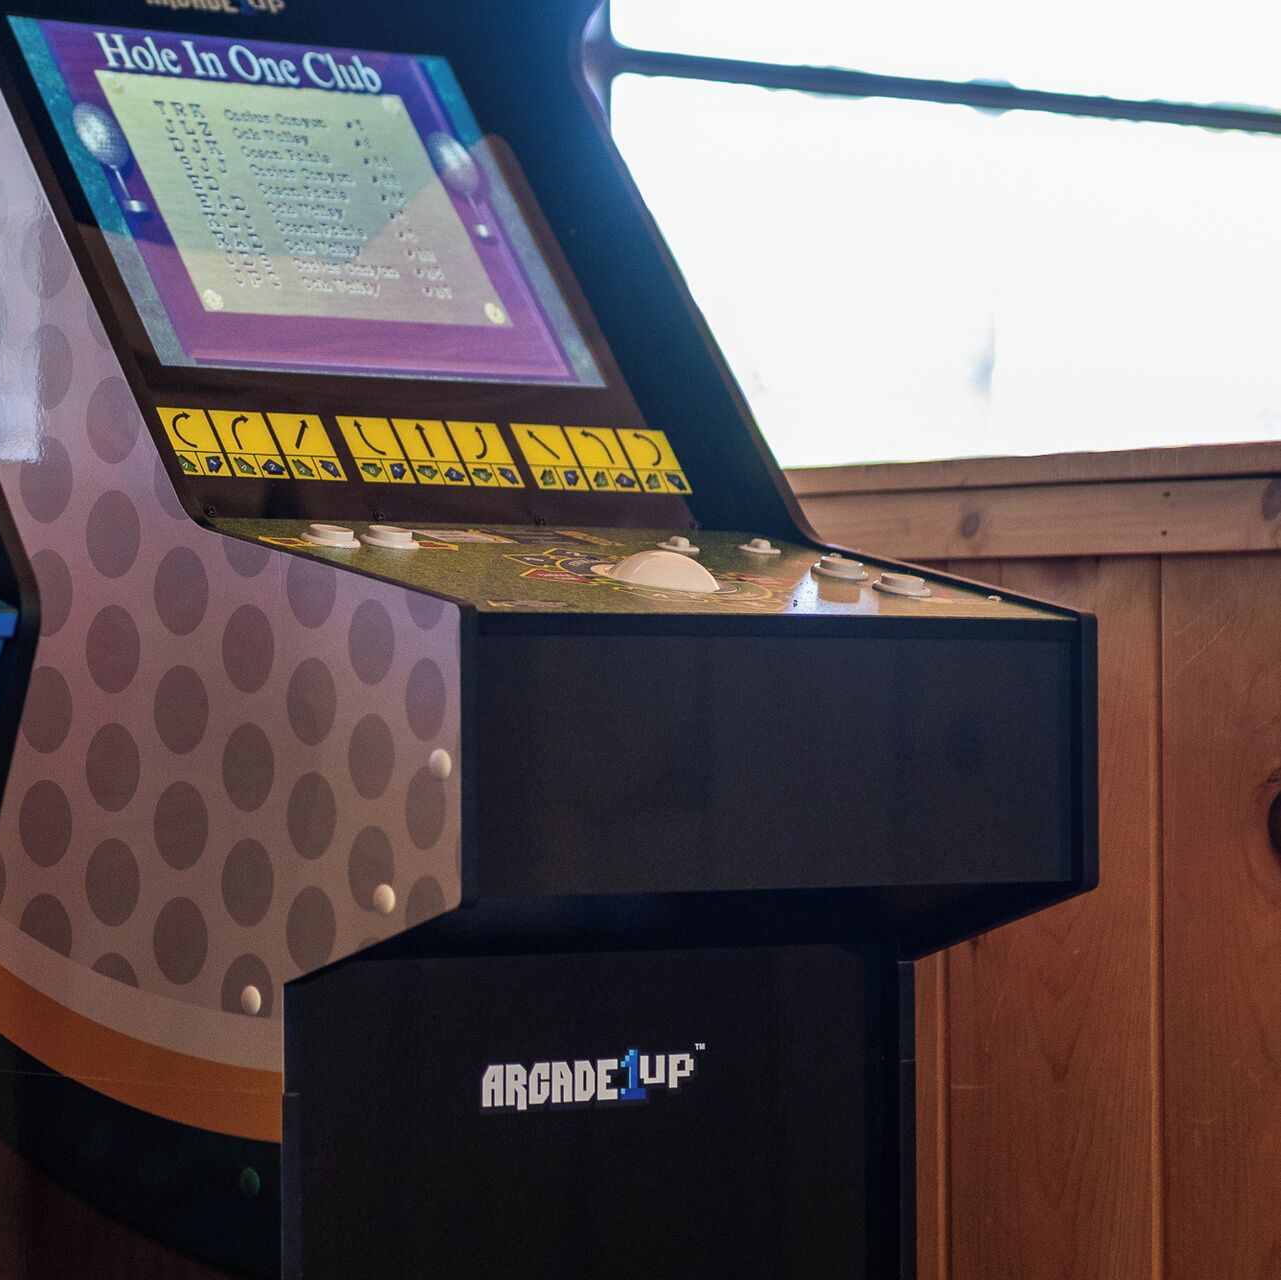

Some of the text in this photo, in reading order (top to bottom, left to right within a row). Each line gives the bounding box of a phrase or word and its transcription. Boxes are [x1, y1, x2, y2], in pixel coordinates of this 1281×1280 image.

[94, 32, 383, 94] Hole In One Club
